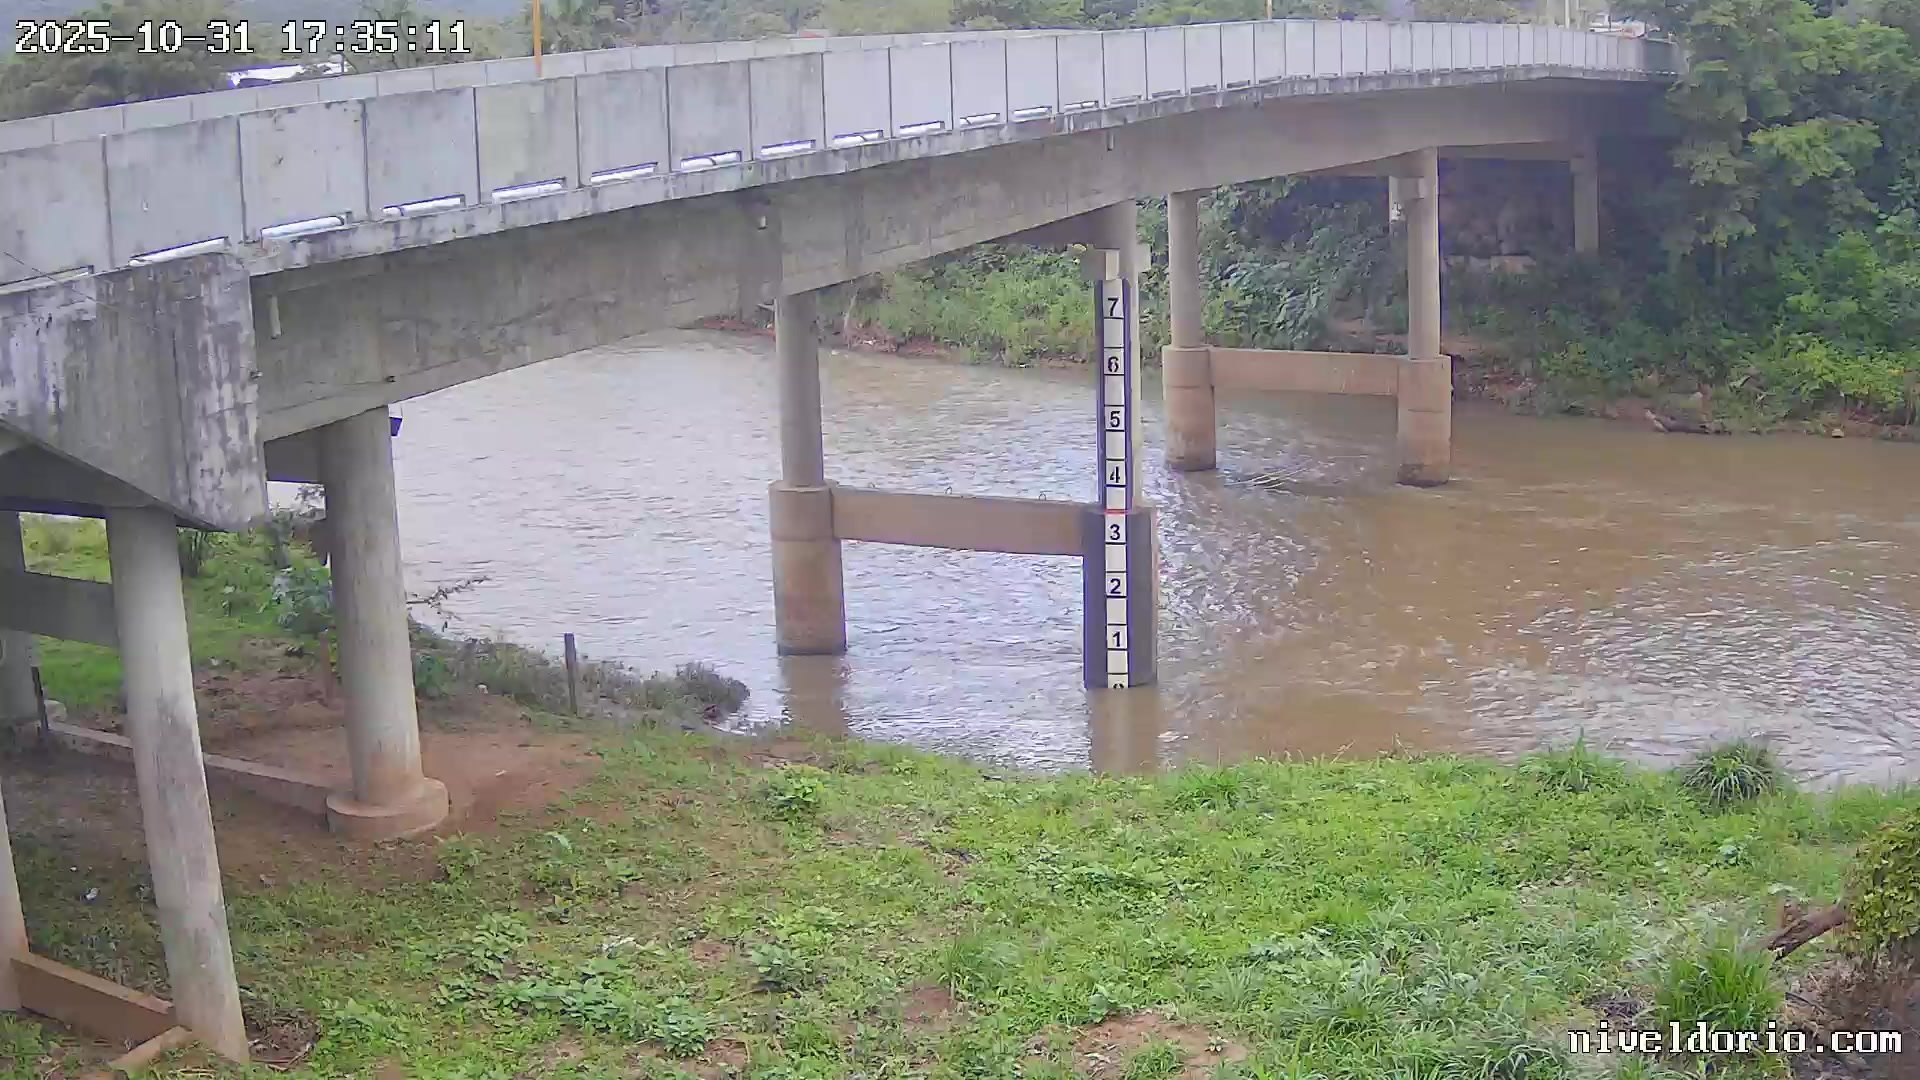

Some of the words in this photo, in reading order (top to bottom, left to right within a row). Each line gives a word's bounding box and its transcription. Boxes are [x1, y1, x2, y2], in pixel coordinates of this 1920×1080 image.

[1107, 297, 1119, 317] 7
[1107, 356, 1119, 373] 6
[1109, 410, 1121, 428] 5
[1109, 466, 1120, 483] 4
[1109, 523, 1121, 541] 3
[1109, 578, 1121, 595] 2
[1112, 631, 1121, 647] 1
